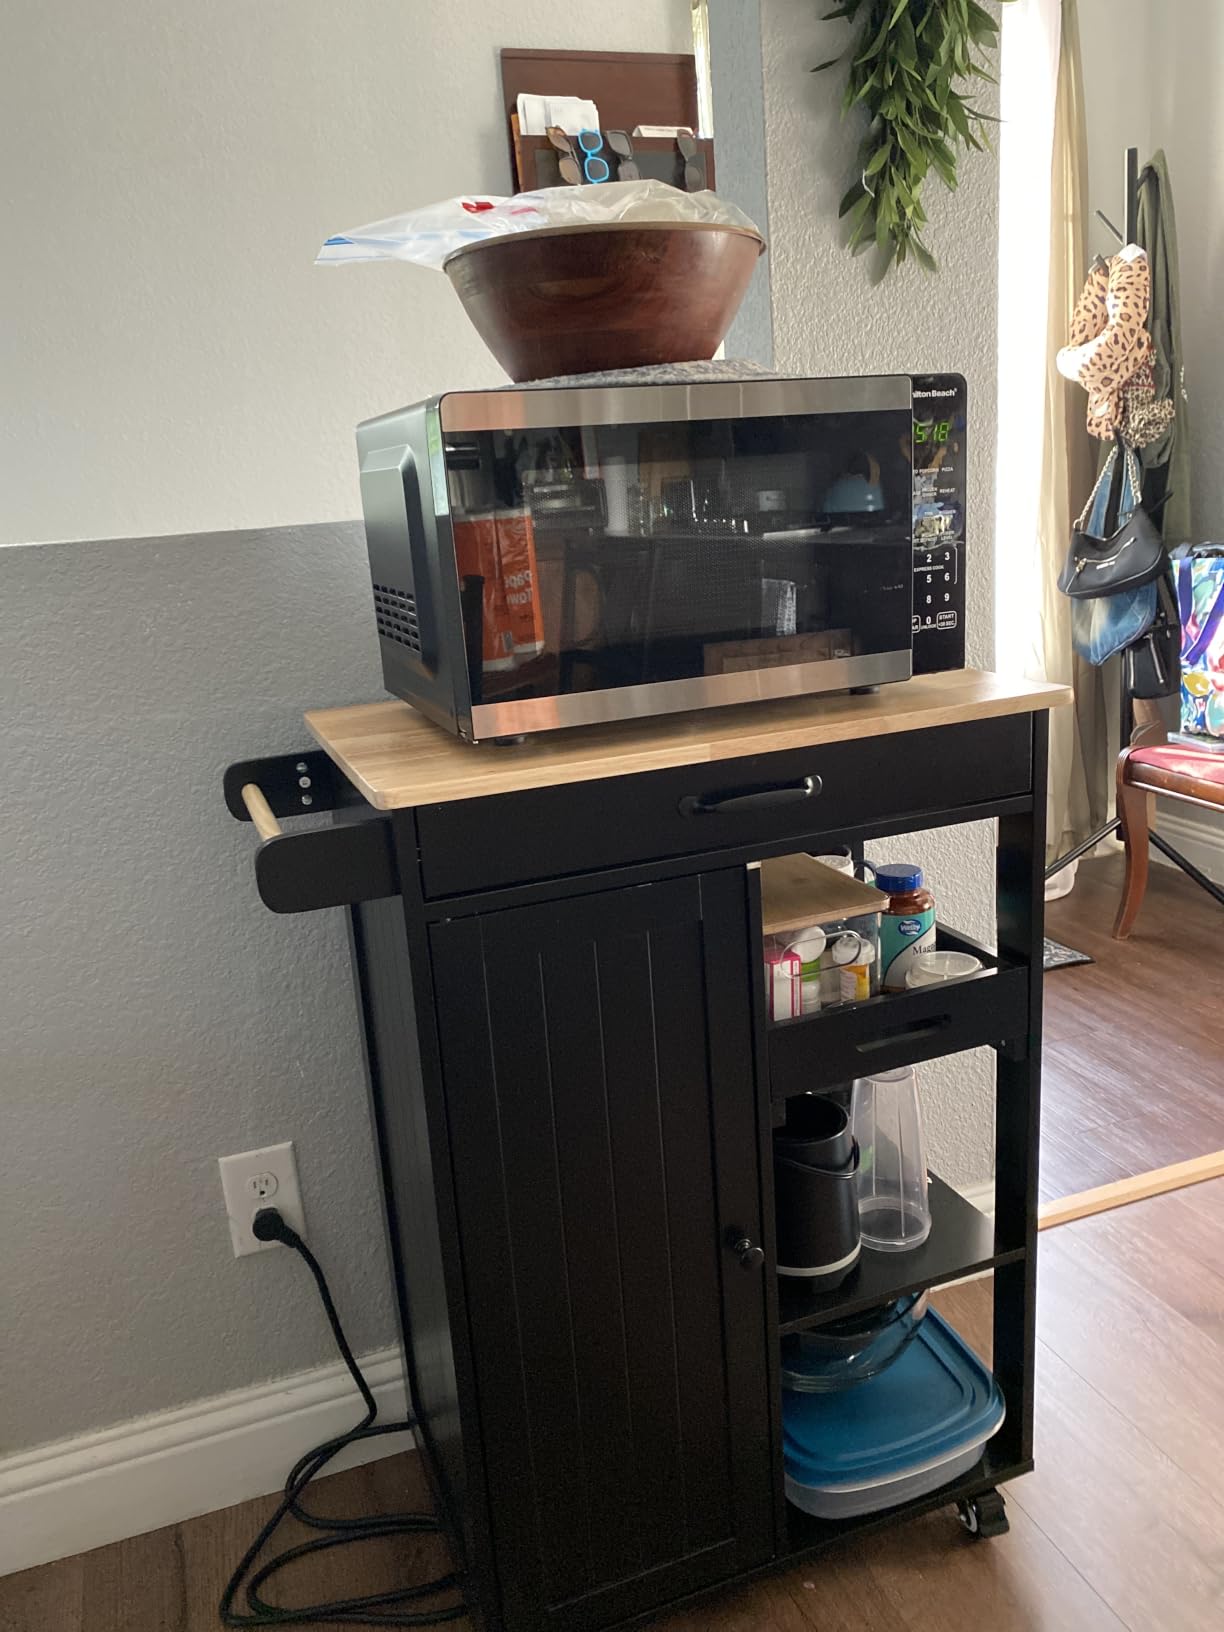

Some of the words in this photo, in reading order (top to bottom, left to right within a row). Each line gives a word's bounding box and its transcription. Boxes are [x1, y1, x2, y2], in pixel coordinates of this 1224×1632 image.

[926, 554, 932, 563] 2
[944, 552, 950, 560] 3
[926, 574, 932, 583] 5
[944, 572, 950, 581] 6
[926, 595, 932, 604] 8
[944, 593, 950, 602] 9
[926, 616, 931, 625] 0
